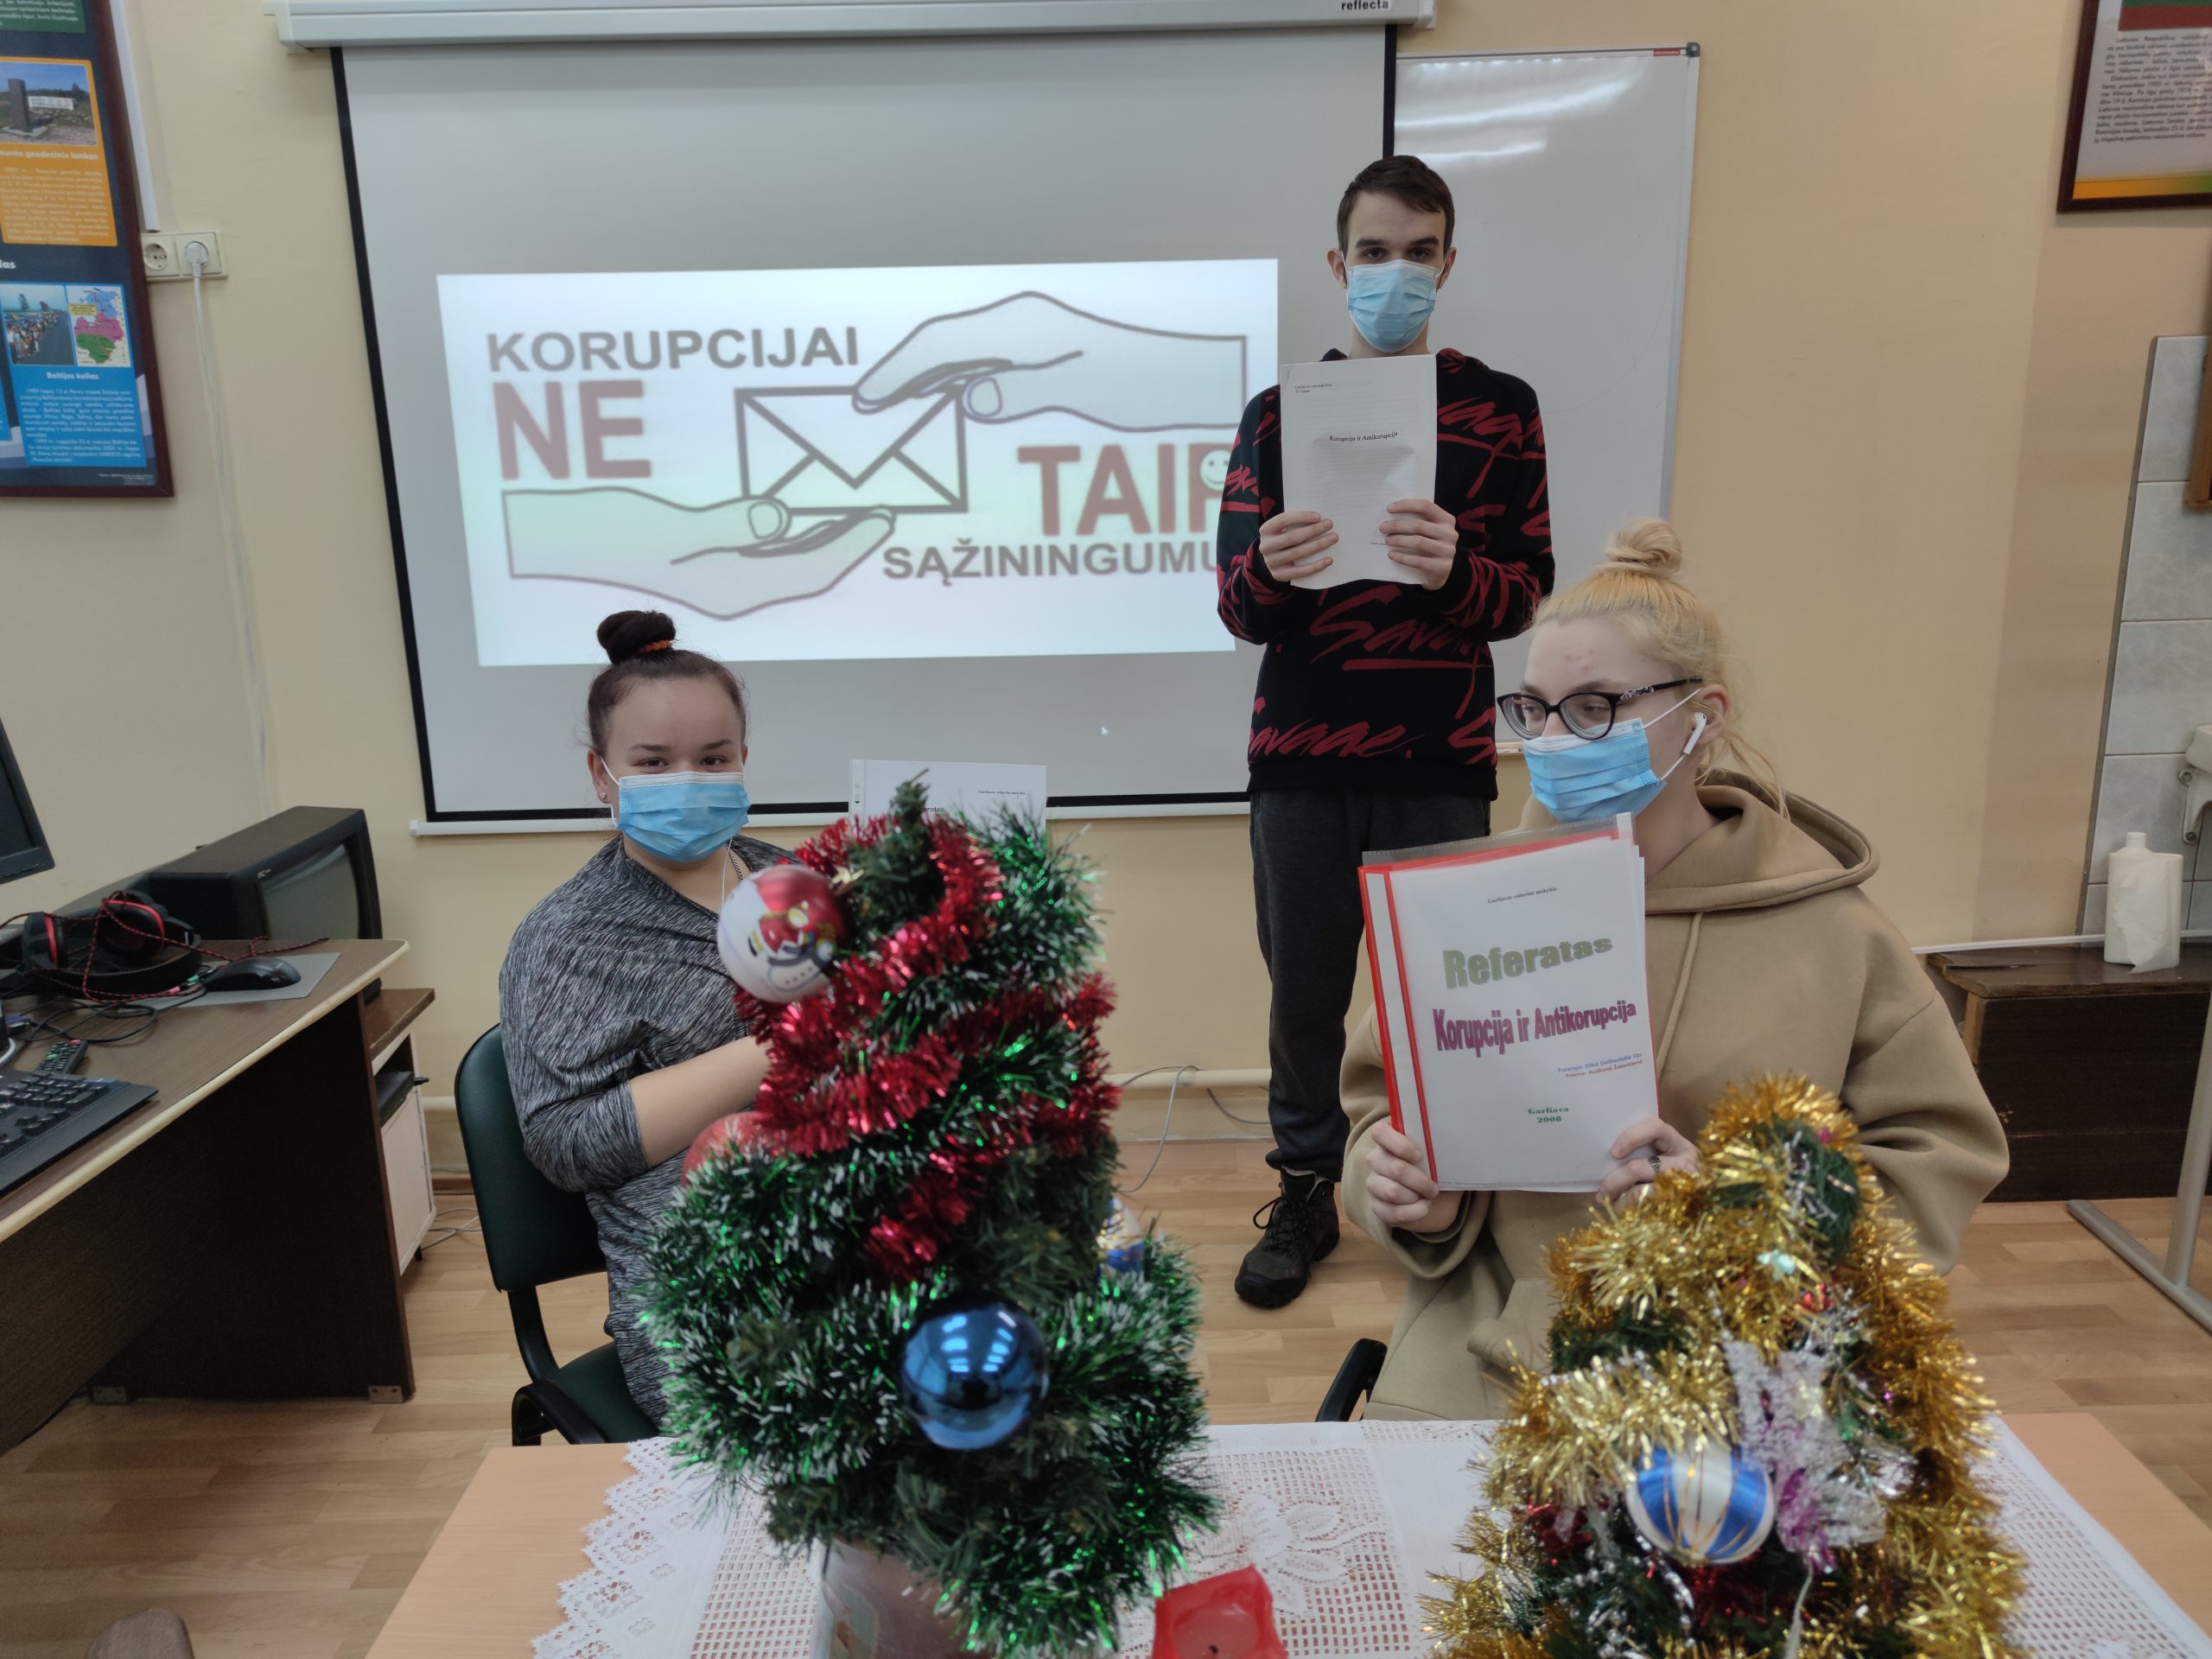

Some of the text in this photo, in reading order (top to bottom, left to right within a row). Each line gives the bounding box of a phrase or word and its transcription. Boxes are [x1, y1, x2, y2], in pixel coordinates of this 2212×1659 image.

[1341, 0, 1389, 10] reflecta
[486, 327, 858, 372] KORUPCIJAI
[493, 379, 652, 480] NE
[1362, 431, 1398, 441] Antikorupcija
[1017, 443, 1234, 537] TAIP
[1442, 936, 1612, 988] Referatas
[1433, 1000, 1637, 1058] Korupcija ir Antikorupcija
